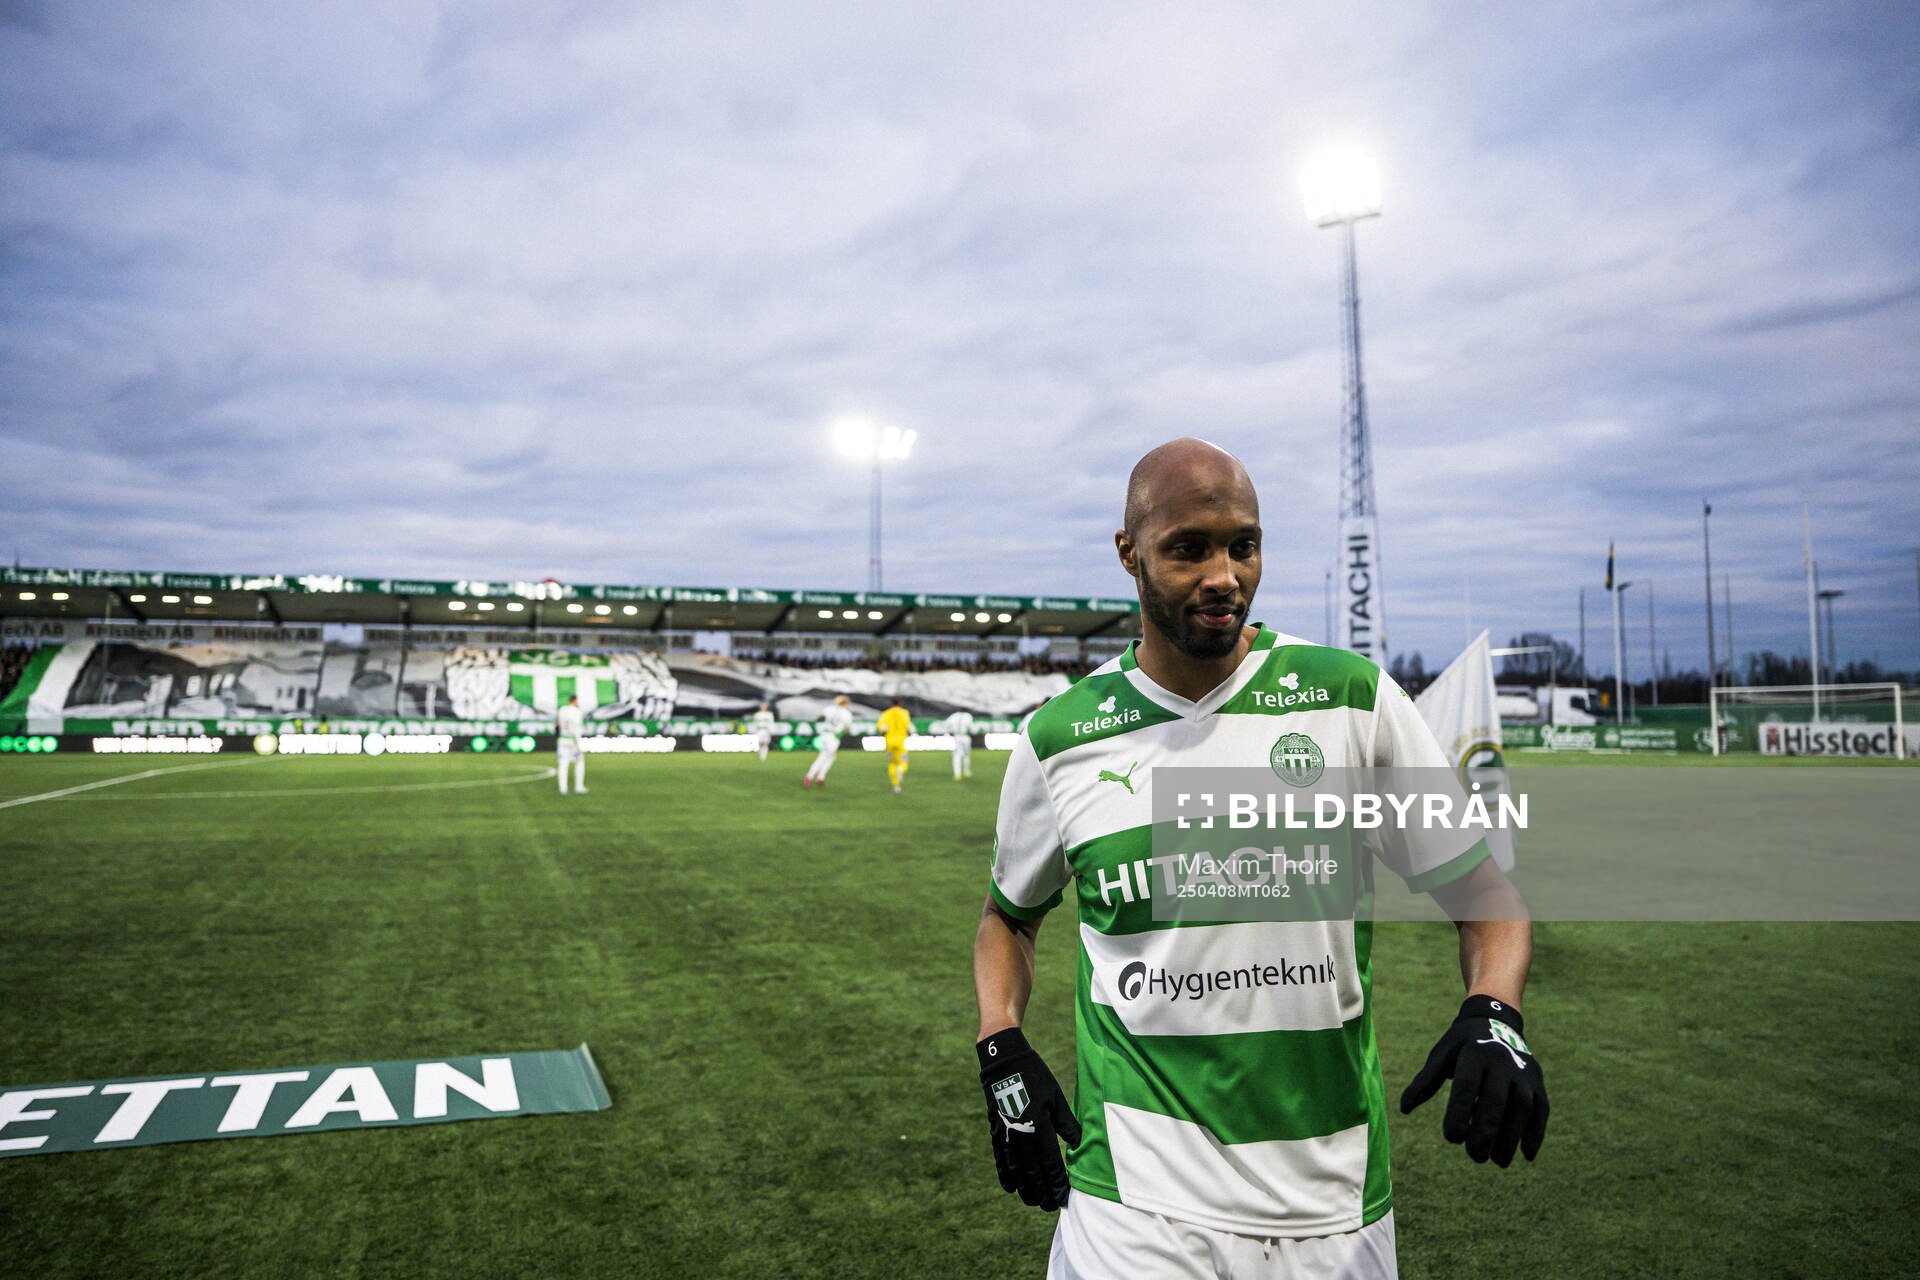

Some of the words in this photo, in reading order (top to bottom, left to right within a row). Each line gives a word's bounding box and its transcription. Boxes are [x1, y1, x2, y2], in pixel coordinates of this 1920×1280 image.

[1348, 535, 1372, 658] ITACHI
[1251, 686, 1331, 709] Telexia
[1071, 707, 1142, 736] Telexia
[1097, 844, 1331, 907] HITACHI
[1149, 954, 1336, 1002] Hygienteknik
[1490, 1001, 1502, 1011] 6
[988, 1041, 998, 1056] 6
[996, 1078, 1017, 1090] VSK
[0, 1057, 521, 1151] ETTAN
